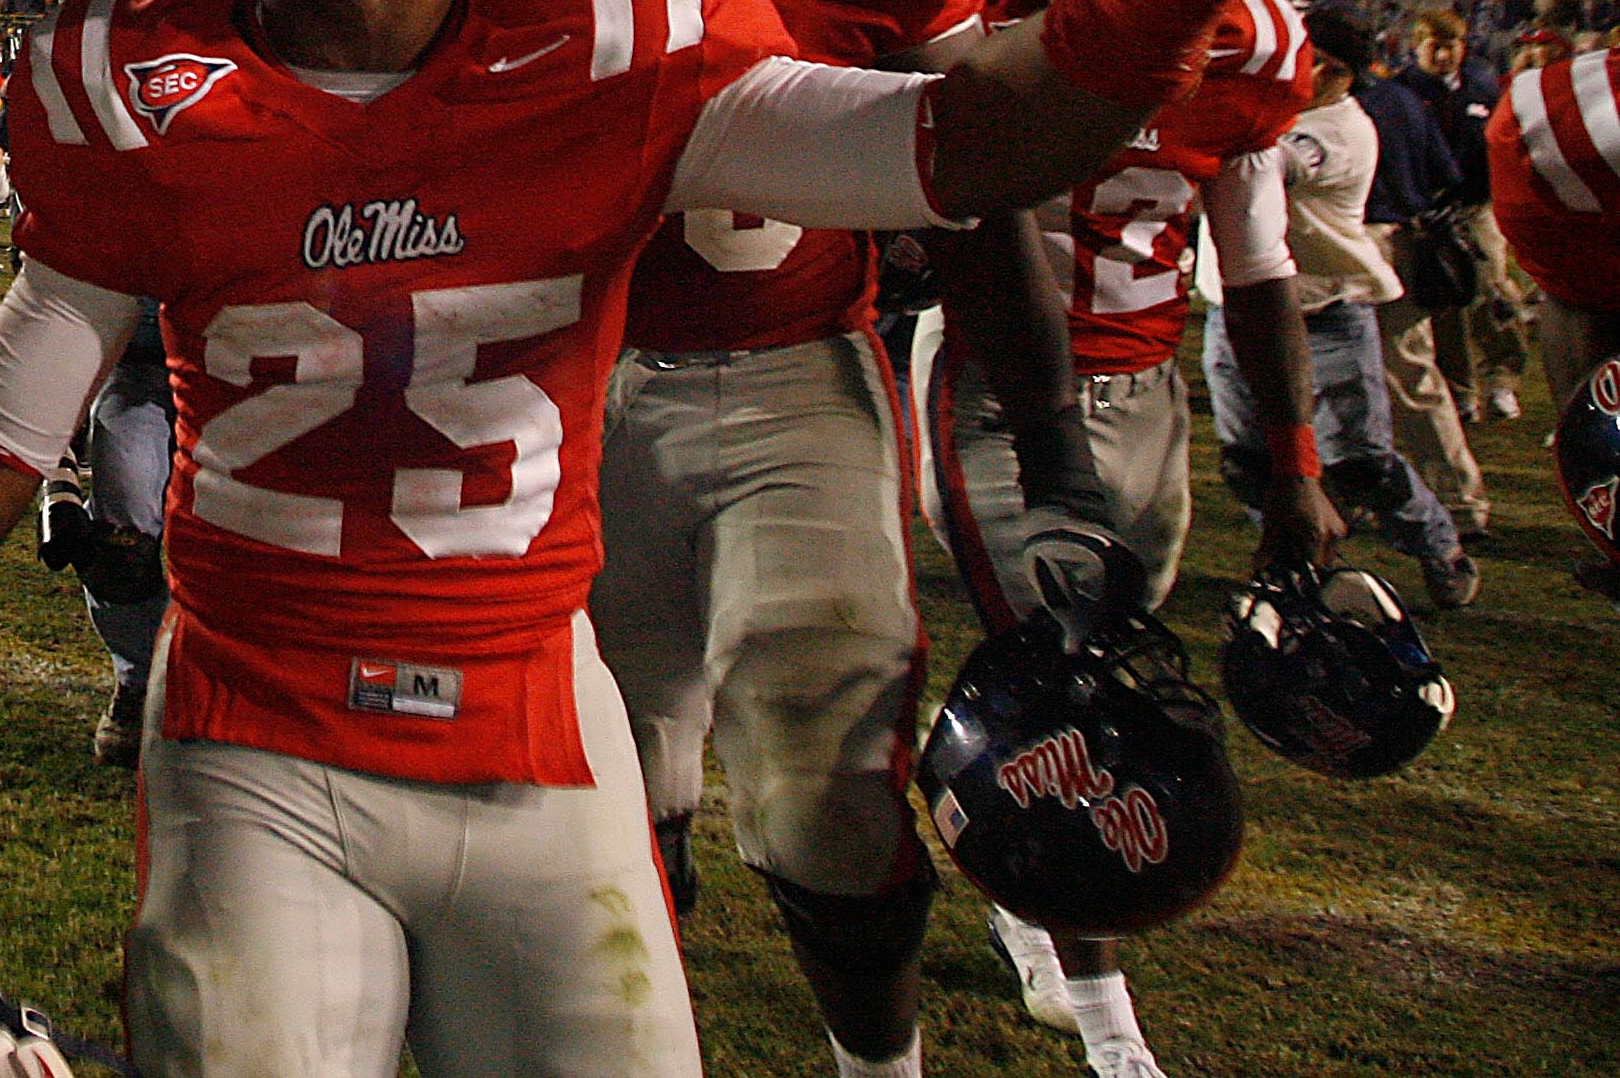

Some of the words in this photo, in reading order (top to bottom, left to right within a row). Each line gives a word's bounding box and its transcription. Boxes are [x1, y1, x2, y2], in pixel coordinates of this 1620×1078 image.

[148, 71, 198, 98] SEC
[303, 203, 365, 268] Ole
[363, 198, 466, 263] Miss
[192, 275, 583, 559] 25
[413, 674, 440, 698] M
[997, 728, 1115, 810] Miss
[1092, 787, 1169, 873] Ole
